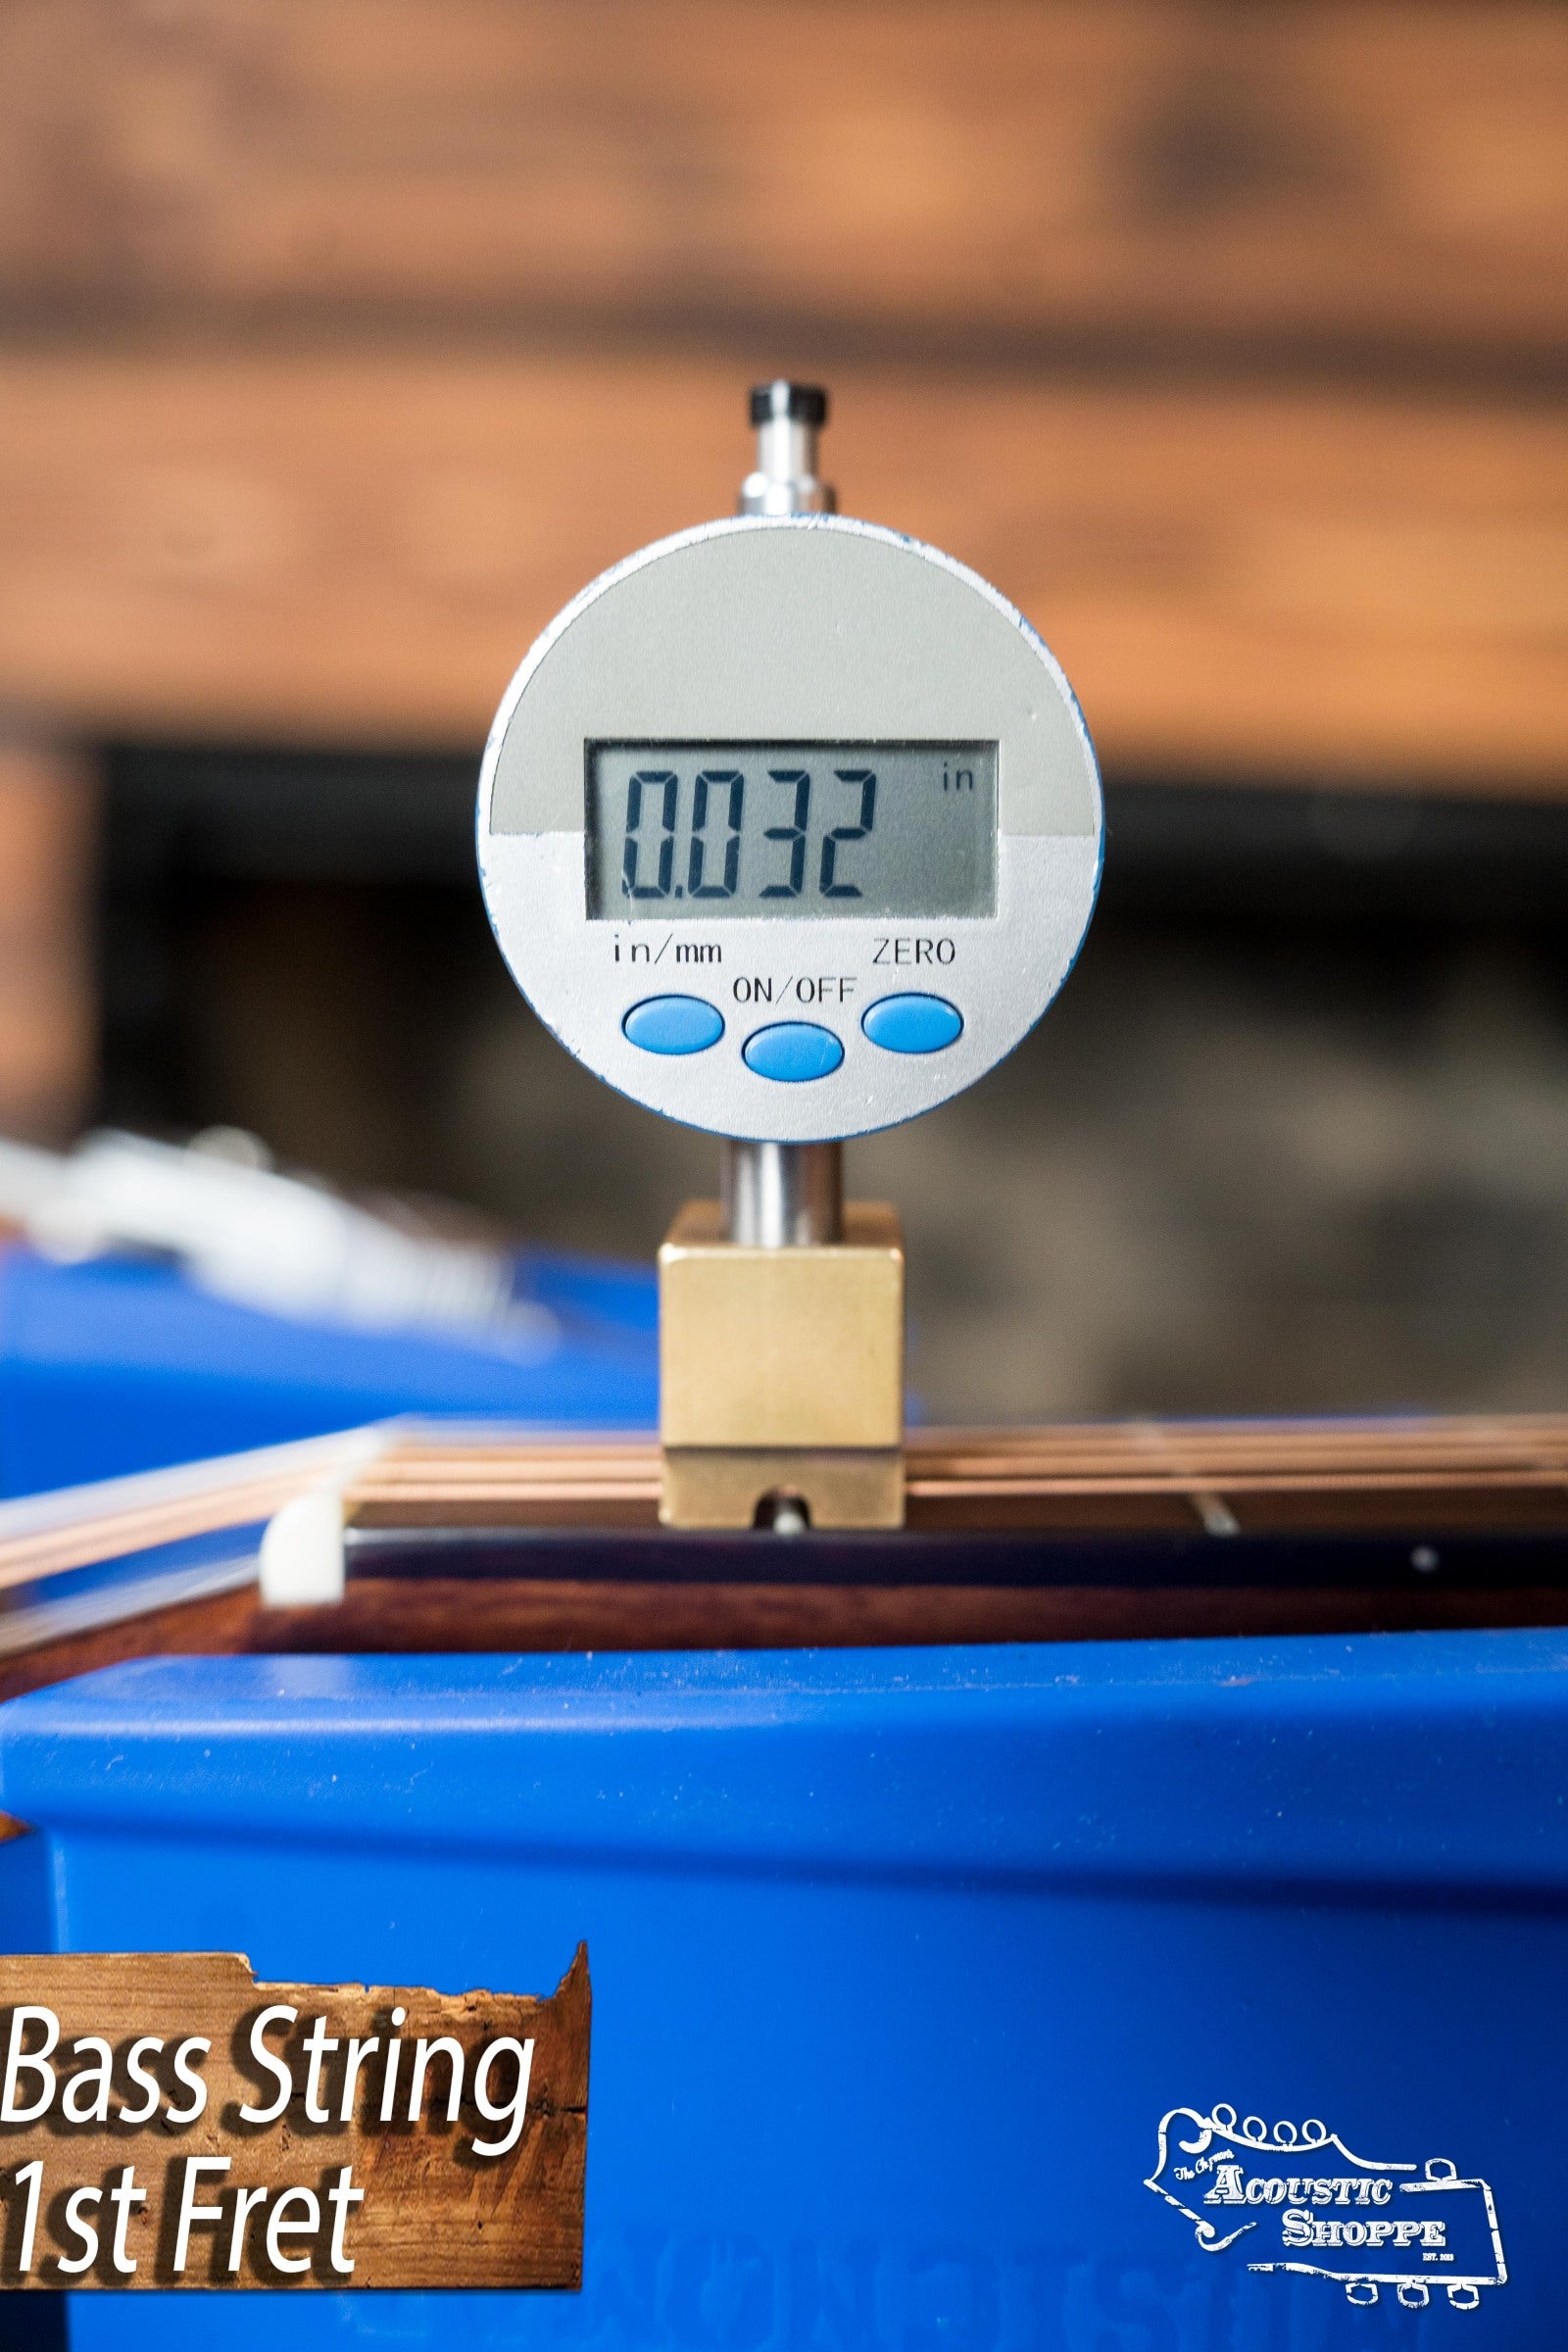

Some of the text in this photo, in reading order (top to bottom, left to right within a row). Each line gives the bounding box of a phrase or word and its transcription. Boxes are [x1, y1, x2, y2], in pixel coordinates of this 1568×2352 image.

[943, 760, 974, 792] in
[621, 769, 877, 899] 0.032
[613, 933, 723, 964] in/mm
[872, 937, 956, 965] ZERO
[732, 975, 858, 1004] ON/OFF
